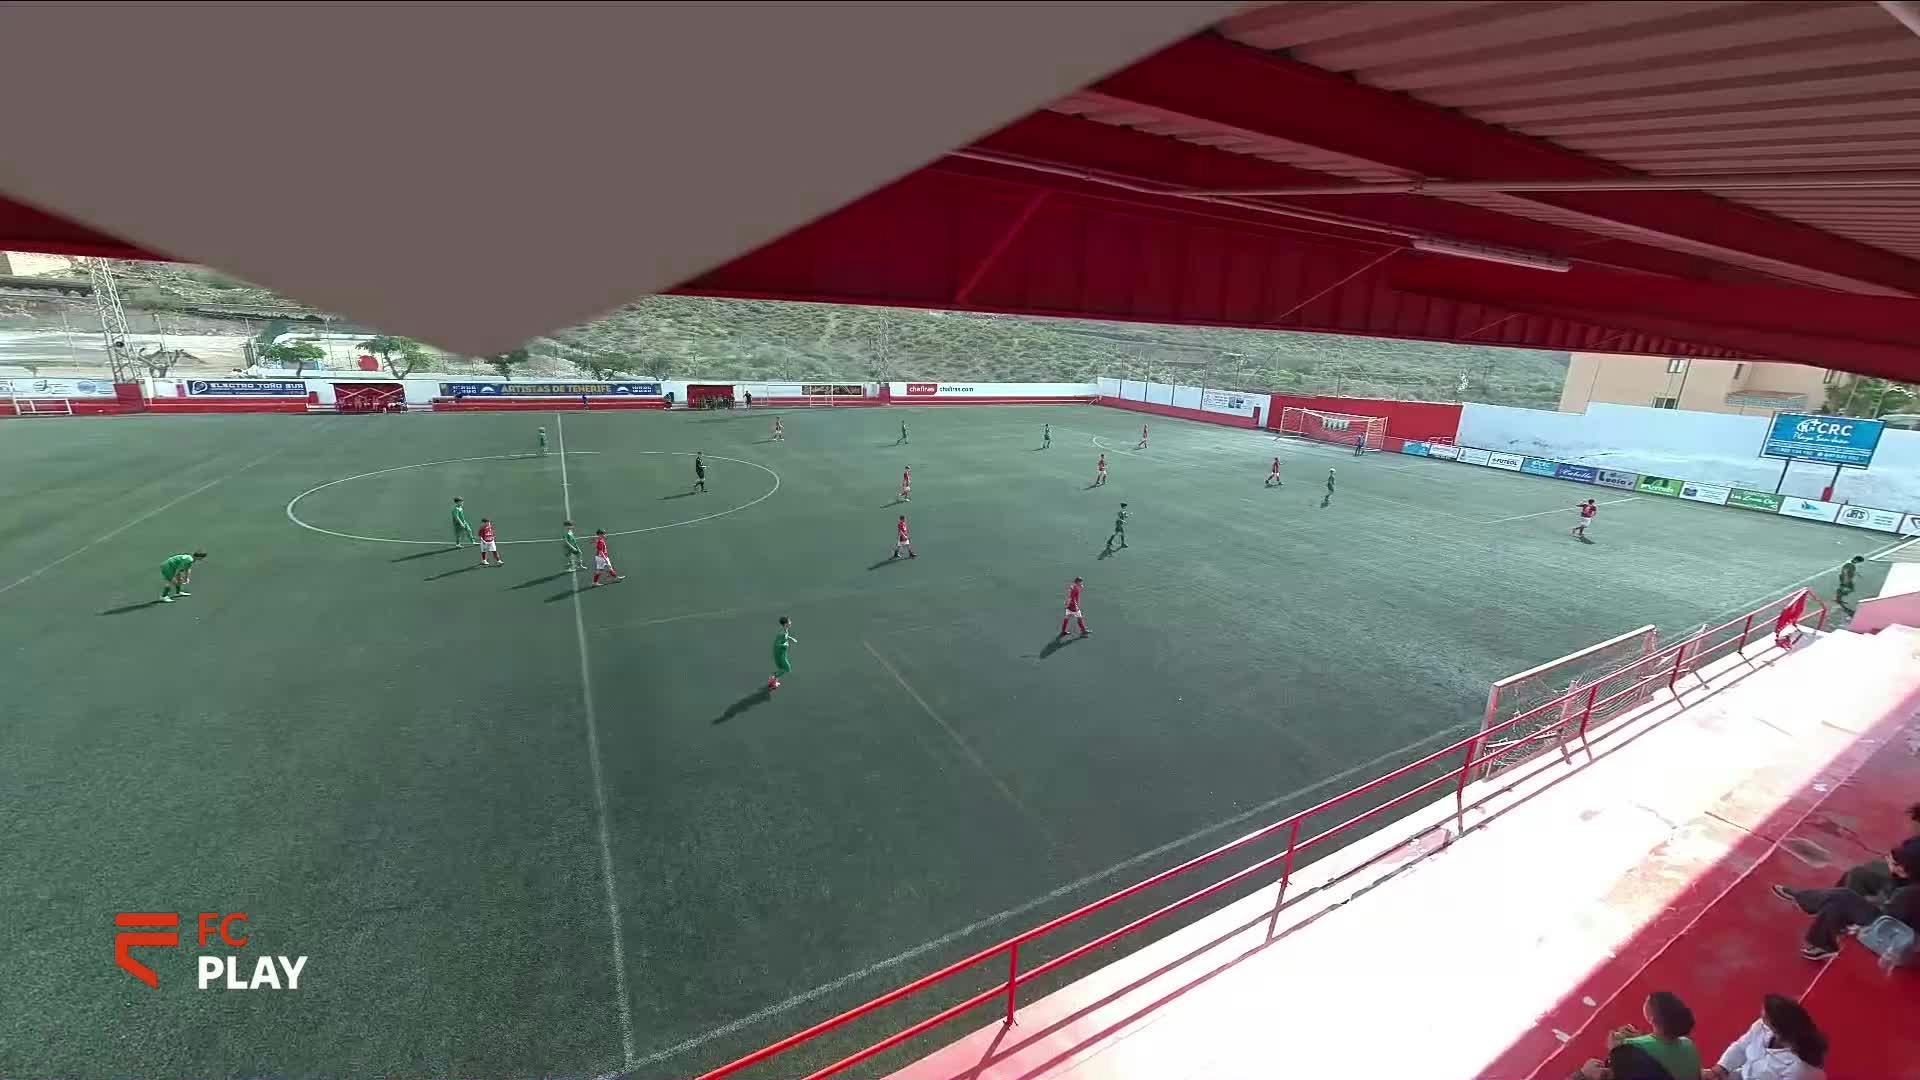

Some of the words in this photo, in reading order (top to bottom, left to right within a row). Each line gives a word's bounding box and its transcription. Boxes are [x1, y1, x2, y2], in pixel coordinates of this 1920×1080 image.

[501, 385, 551, 393] ARTISTAS
[552, 385, 566, 393] DE
[568, 385, 612, 393] TENERIFE
[1817, 422, 1854, 437] CRC
